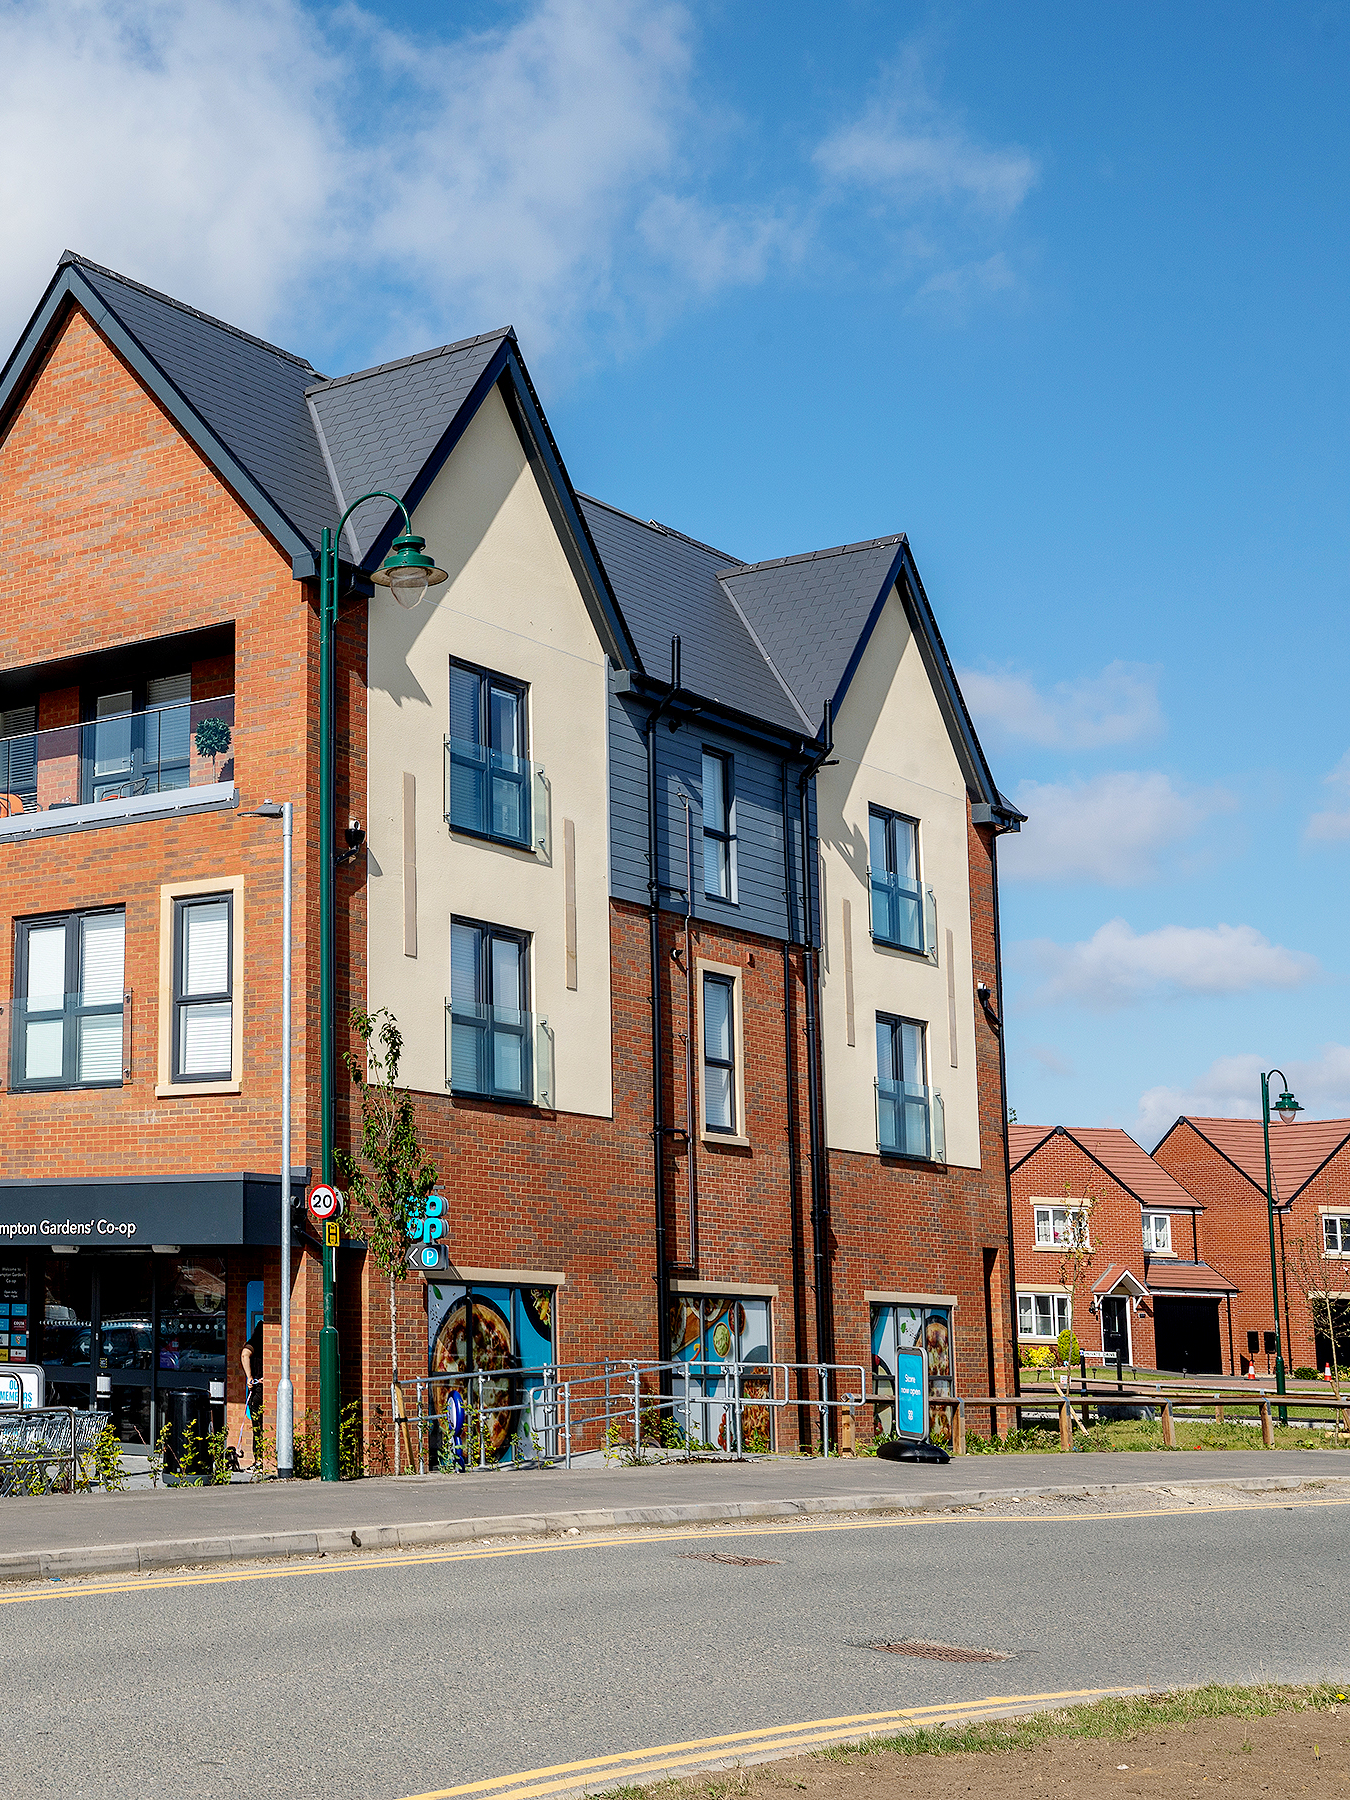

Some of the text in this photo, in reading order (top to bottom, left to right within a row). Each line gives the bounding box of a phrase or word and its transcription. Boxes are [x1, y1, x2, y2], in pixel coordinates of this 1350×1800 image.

[312, 1194, 332, 1208] 20
[39, 1218, 95, 1235] Gardens’
[97, 1218, 137, 1239] Co-op
[327, 1224, 338, 1245] H
[426, 1250, 435, 1264] P
[904, 1374, 916, 1384] Store
[910, 1388, 921, 1396] open
